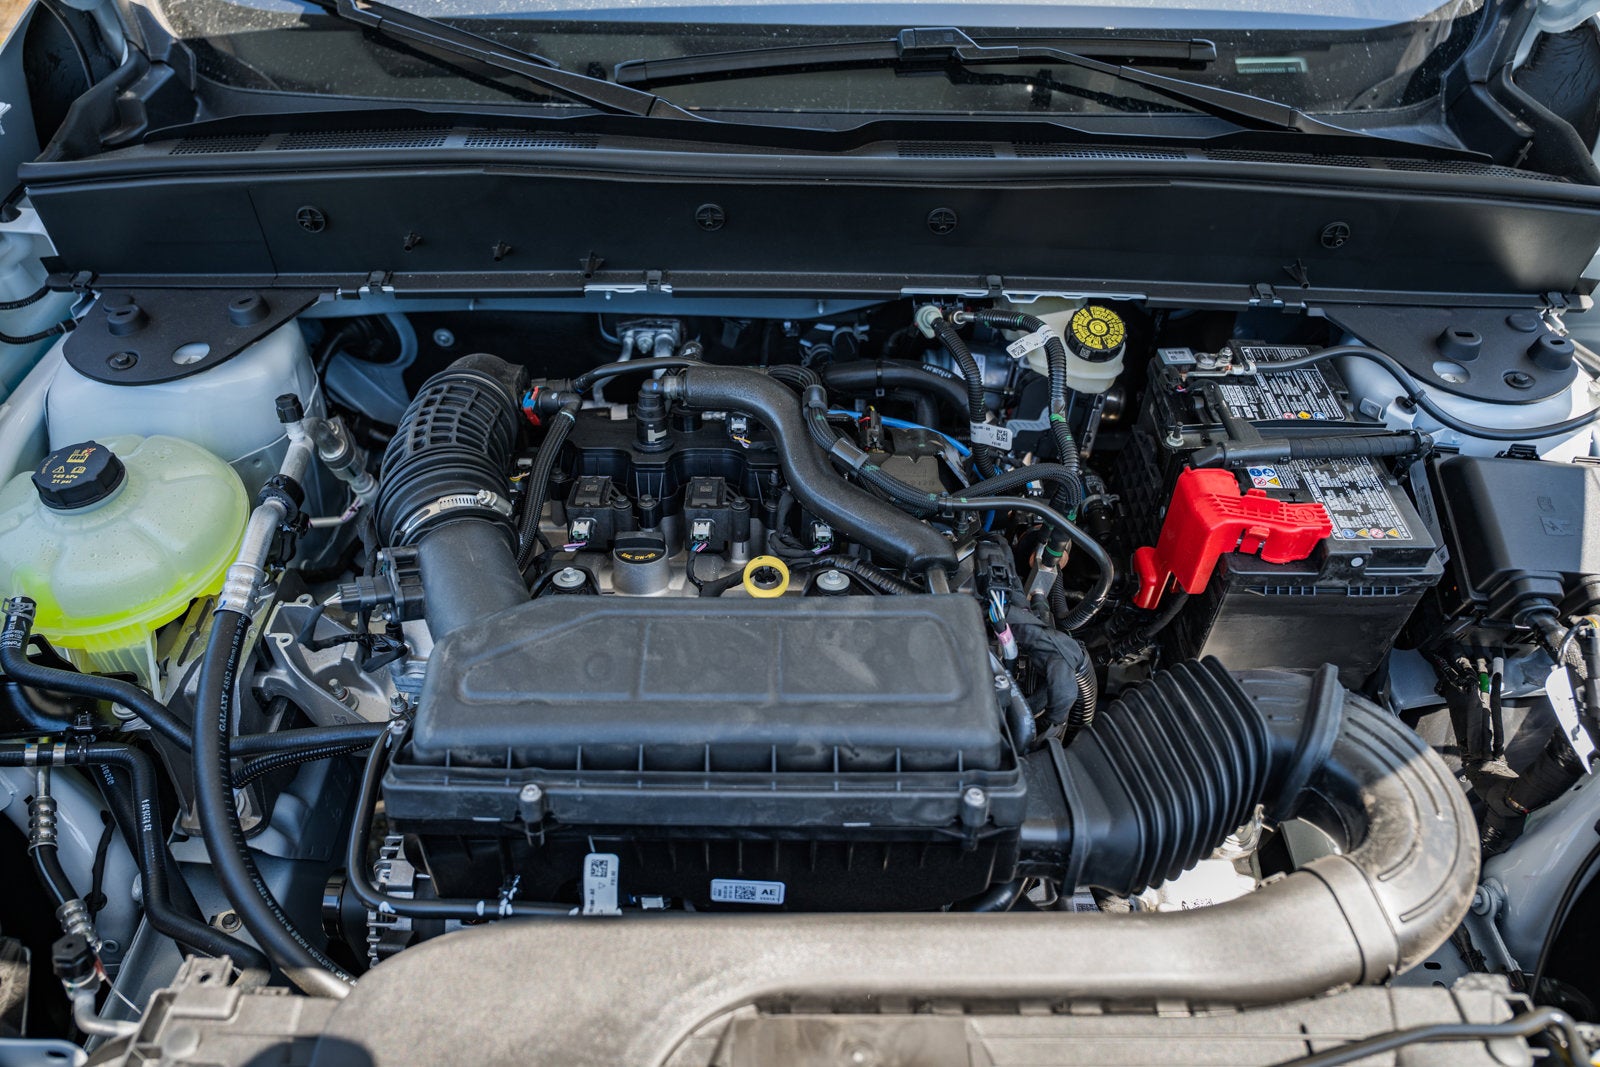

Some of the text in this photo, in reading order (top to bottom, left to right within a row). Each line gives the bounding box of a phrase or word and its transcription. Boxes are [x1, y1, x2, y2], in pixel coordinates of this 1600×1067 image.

[219, 691, 229, 732] GALAXY
[291, 930, 309, 949] HOSE
[308, 947, 337, 973] SUCTION
[336, 970, 349, 981] A/C
